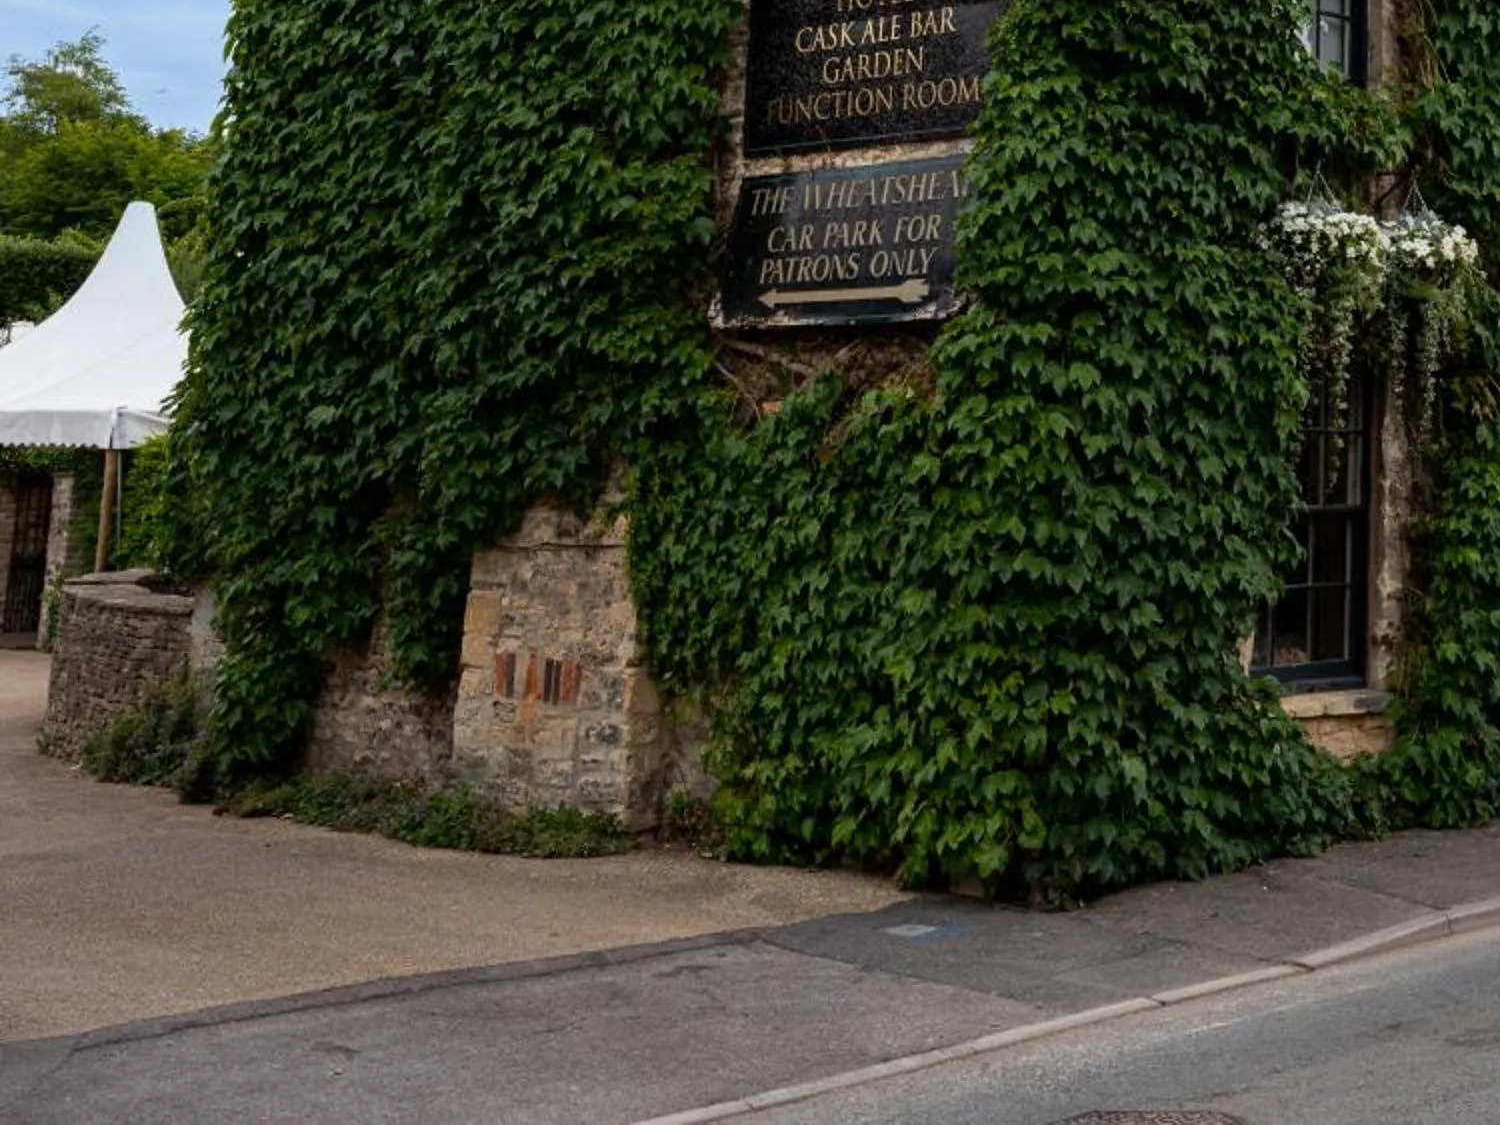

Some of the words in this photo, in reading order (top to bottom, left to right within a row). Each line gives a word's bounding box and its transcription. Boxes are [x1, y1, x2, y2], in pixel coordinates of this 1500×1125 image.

[796, 20, 856, 53] CASK
[861, 14, 901, 45] ALE
[910, 6, 957, 39] BAR
[823, 46, 925, 84] GARDEN
[768, 86, 893, 125] FUNCTION
[903, 76, 981, 111] ROOM
[751, 186, 795, 217] THE
[803, 169, 970, 211] WHEATSHEA
[767, 225, 814, 254] CAR
[823, 216, 883, 249] PARK
[894, 213, 942, 245] FOR
[759, 250, 861, 284] PATRONS
[869, 245, 939, 278] ONLY
